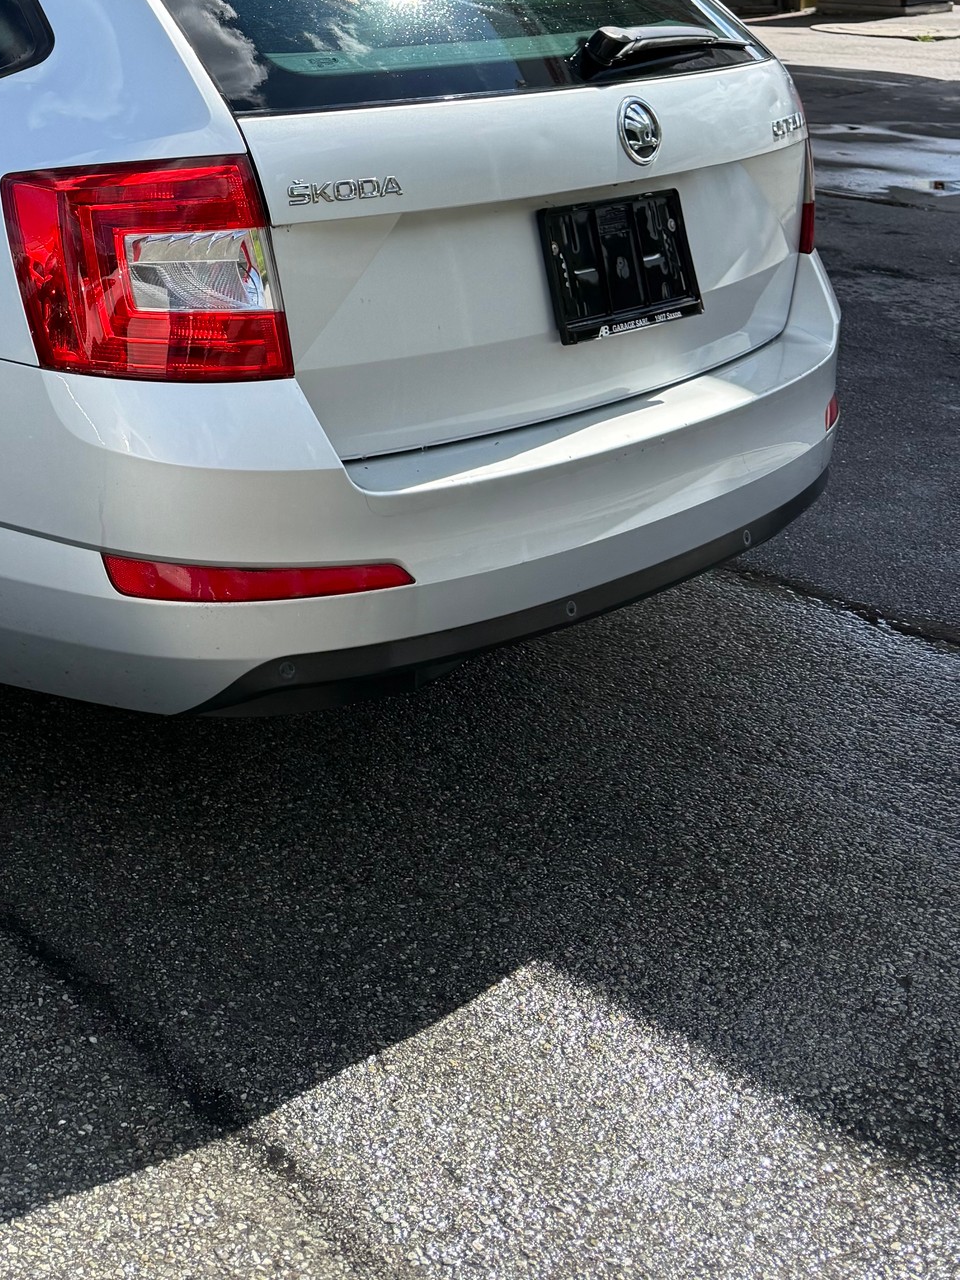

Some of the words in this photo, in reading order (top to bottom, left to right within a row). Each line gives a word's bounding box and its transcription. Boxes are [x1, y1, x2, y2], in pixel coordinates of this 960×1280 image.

[287, 176, 403, 206] ŠKODA
[612, 320, 635, 333] GARAGE
[667, 311, 682, 320] Saxon
